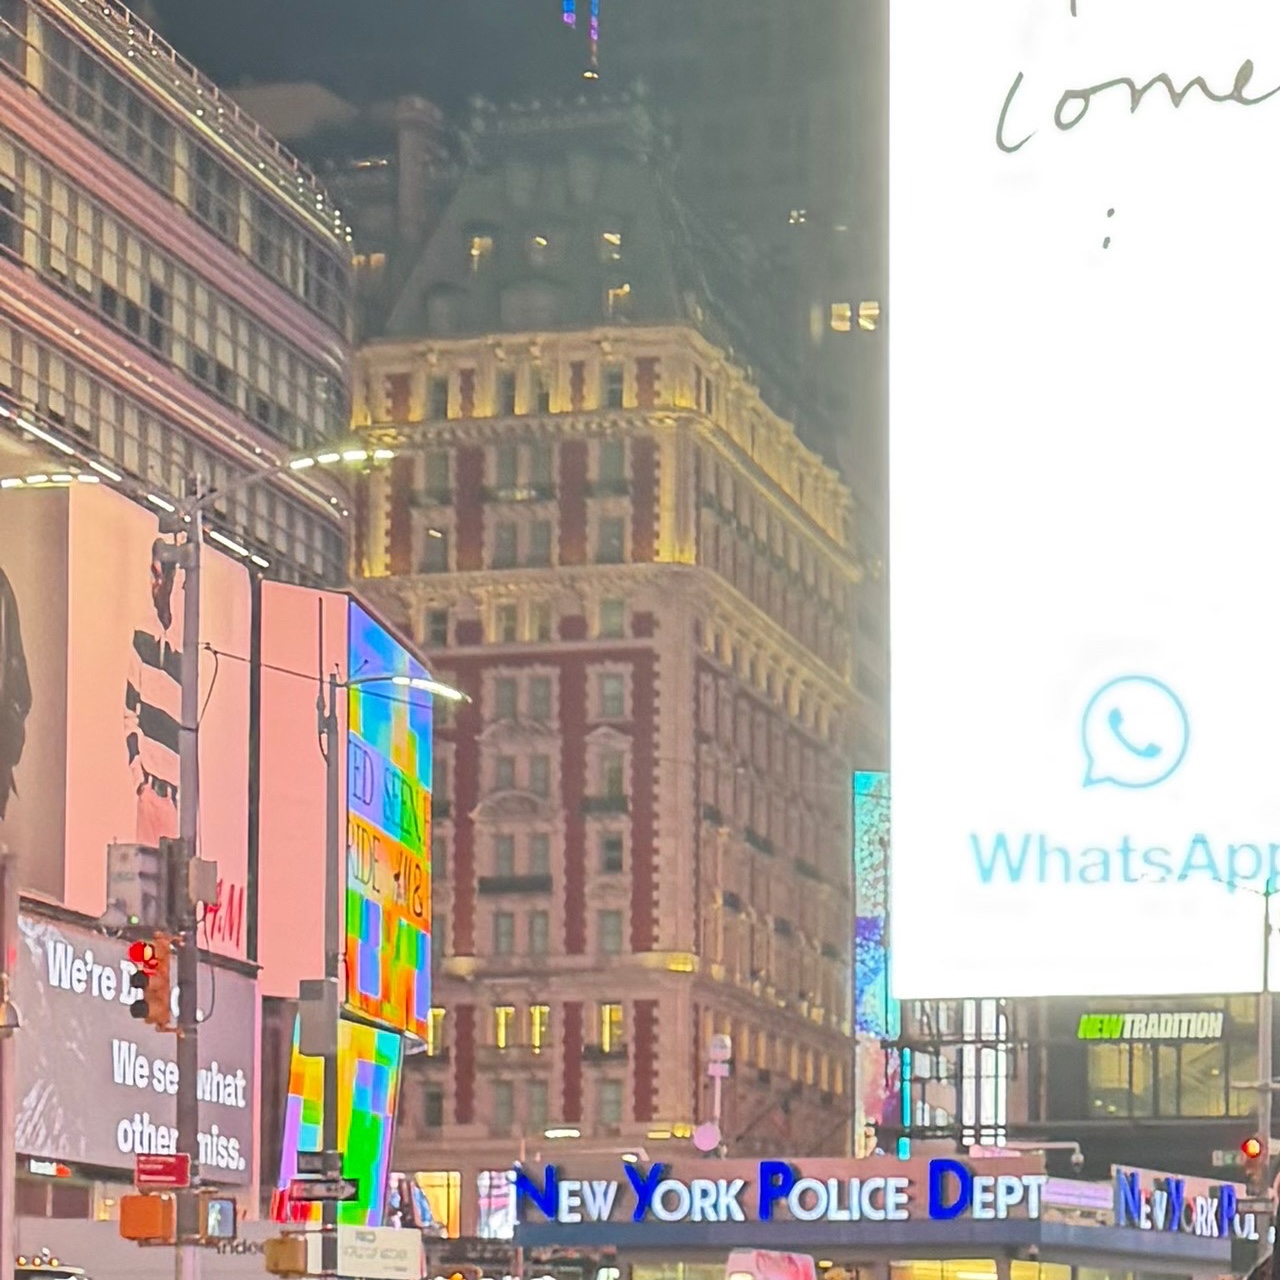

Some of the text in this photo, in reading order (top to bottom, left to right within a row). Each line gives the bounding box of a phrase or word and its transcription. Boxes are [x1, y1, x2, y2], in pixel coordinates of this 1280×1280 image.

[47, 939, 117, 1001] We're
[112, 1038, 247, 1108] We se what
[117, 1112, 179, 1155] other
[513, 1158, 1049, 1222] NEW YORK POLICE DEPT
